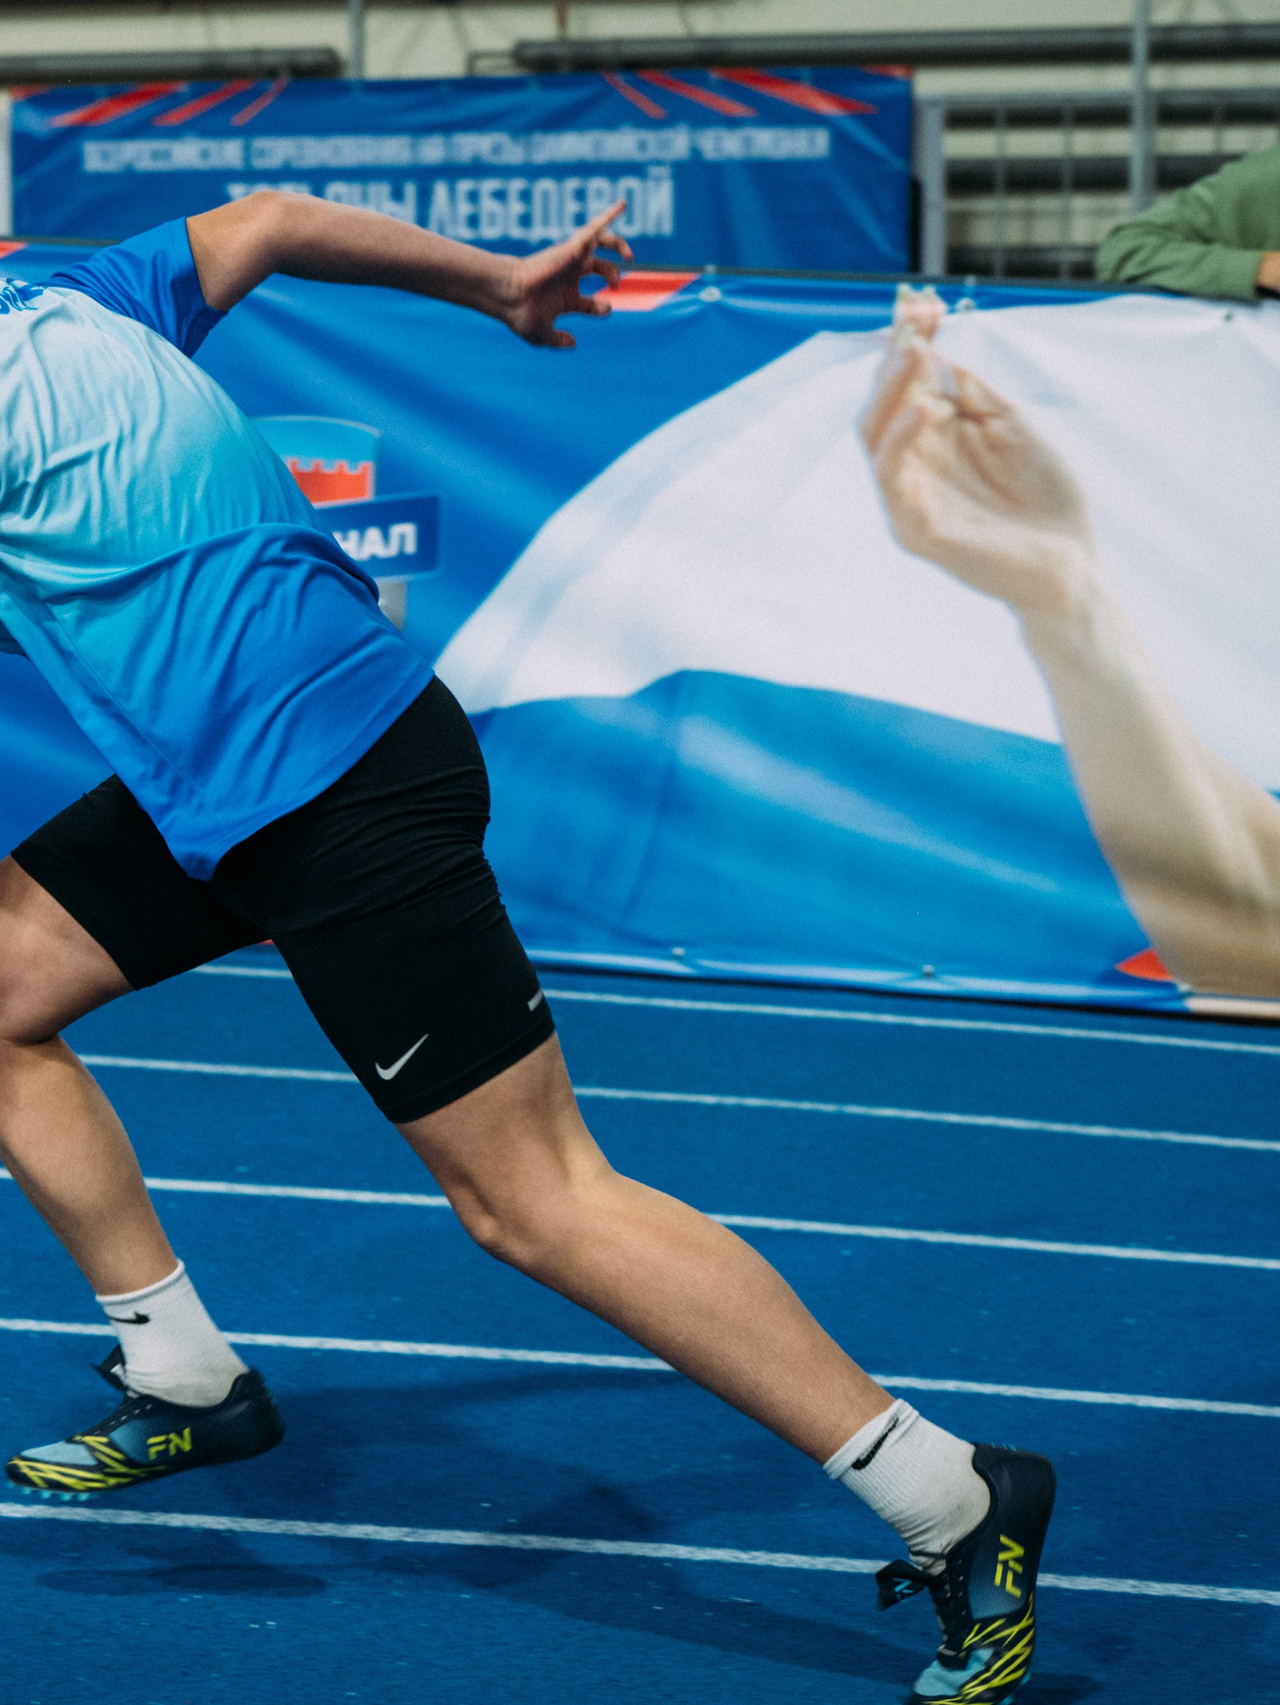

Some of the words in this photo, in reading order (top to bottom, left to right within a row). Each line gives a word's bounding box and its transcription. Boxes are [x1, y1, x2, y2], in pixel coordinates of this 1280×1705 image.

[332, 521, 417, 562] НАЛ
[147, 1427, 192, 1460] FN
[994, 1534, 1024, 1598] FN
